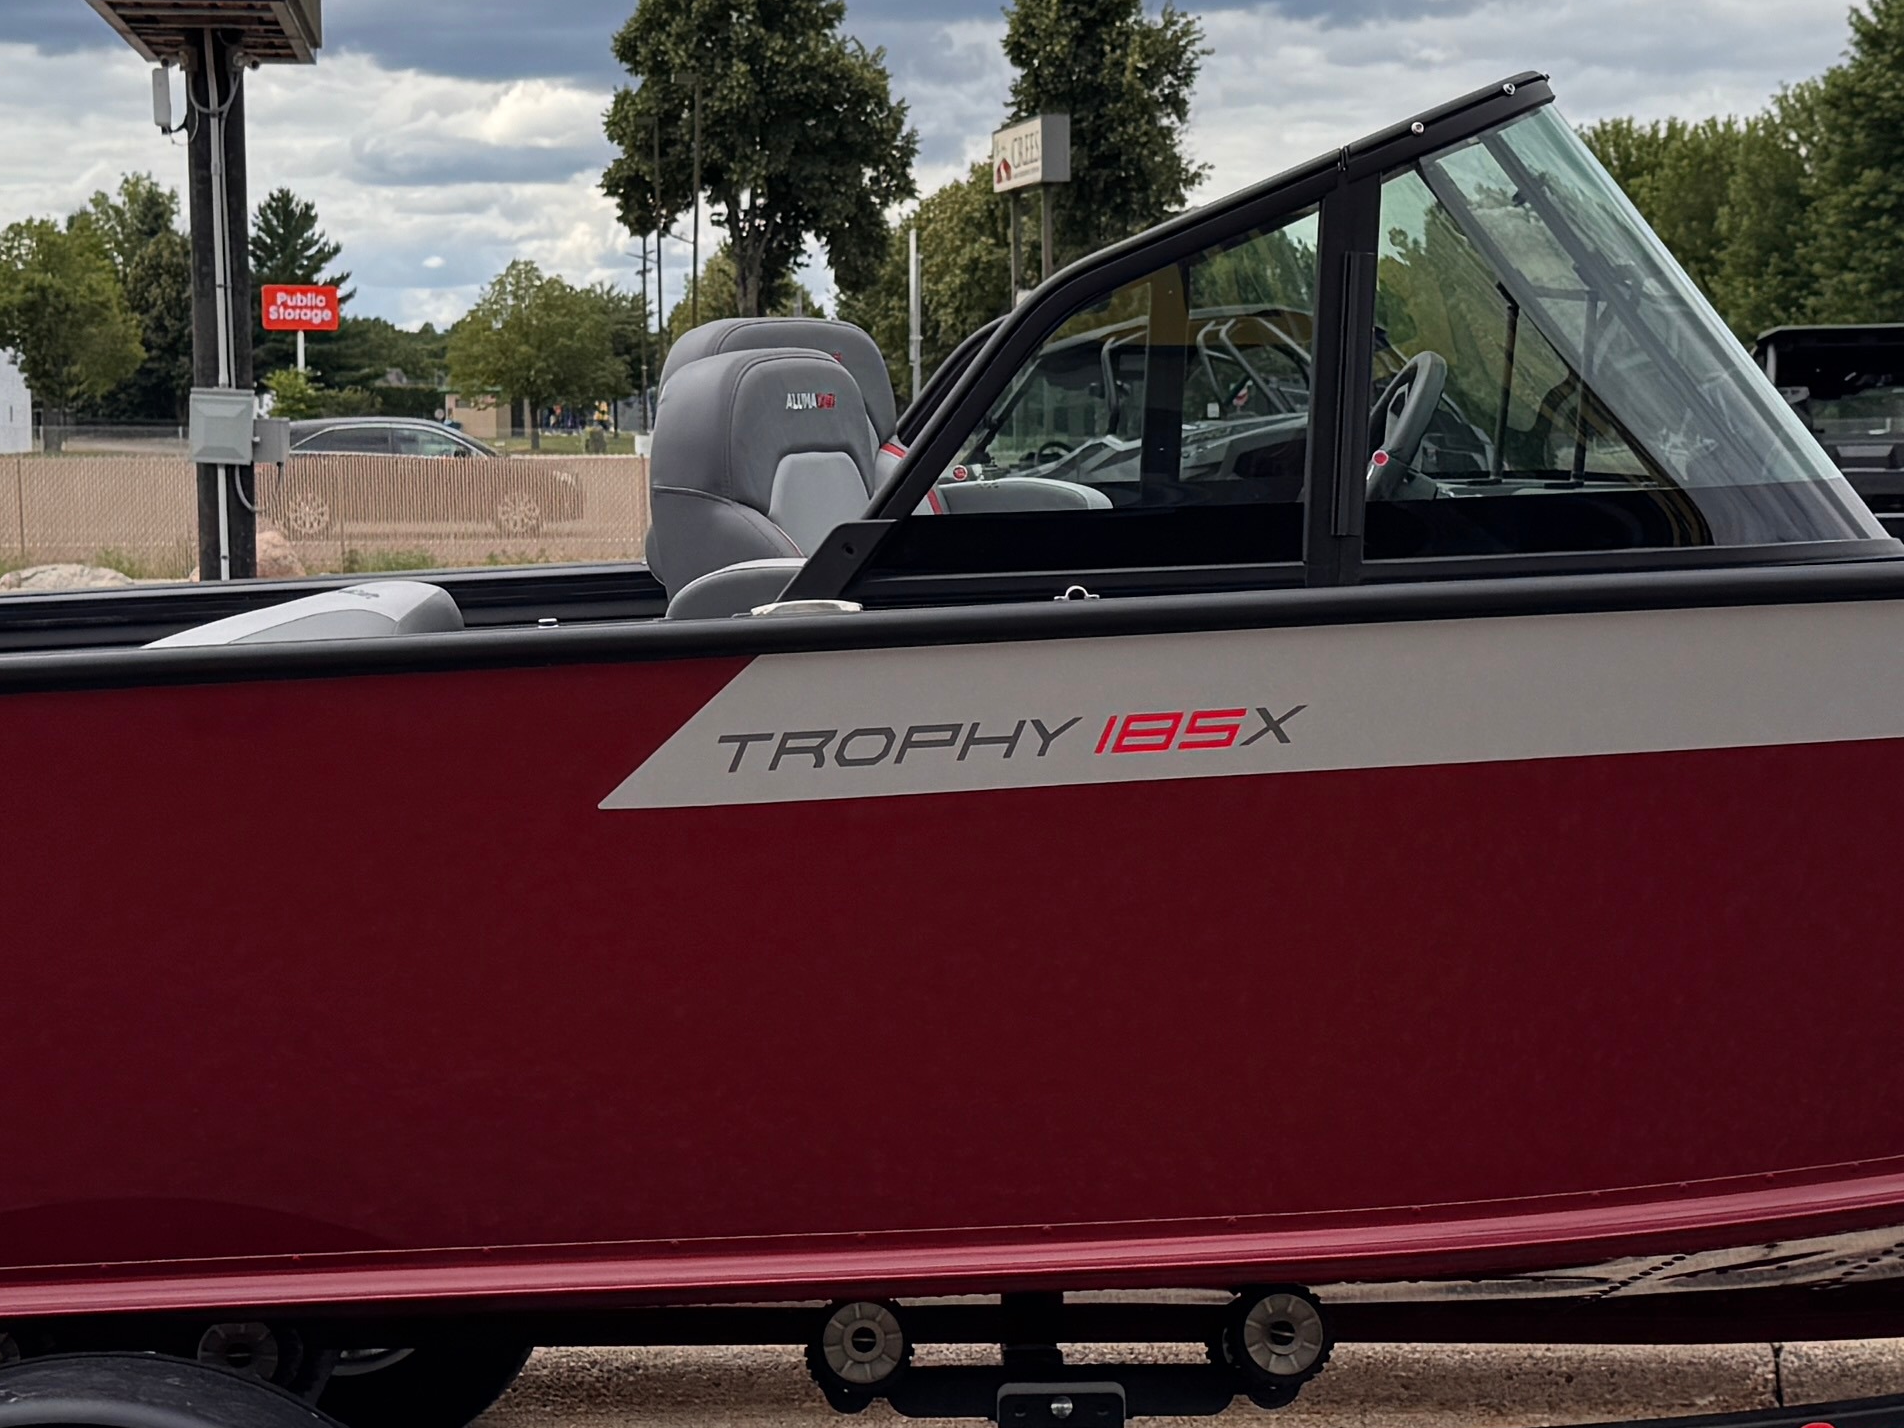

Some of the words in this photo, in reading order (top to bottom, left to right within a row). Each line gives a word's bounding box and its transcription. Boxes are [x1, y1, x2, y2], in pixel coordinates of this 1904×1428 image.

[276, 291, 326, 308] Public
[269, 305, 333, 325] Storage
[718, 716, 1084, 773] TROPHY
[1094, 704, 1309, 755] 185X
